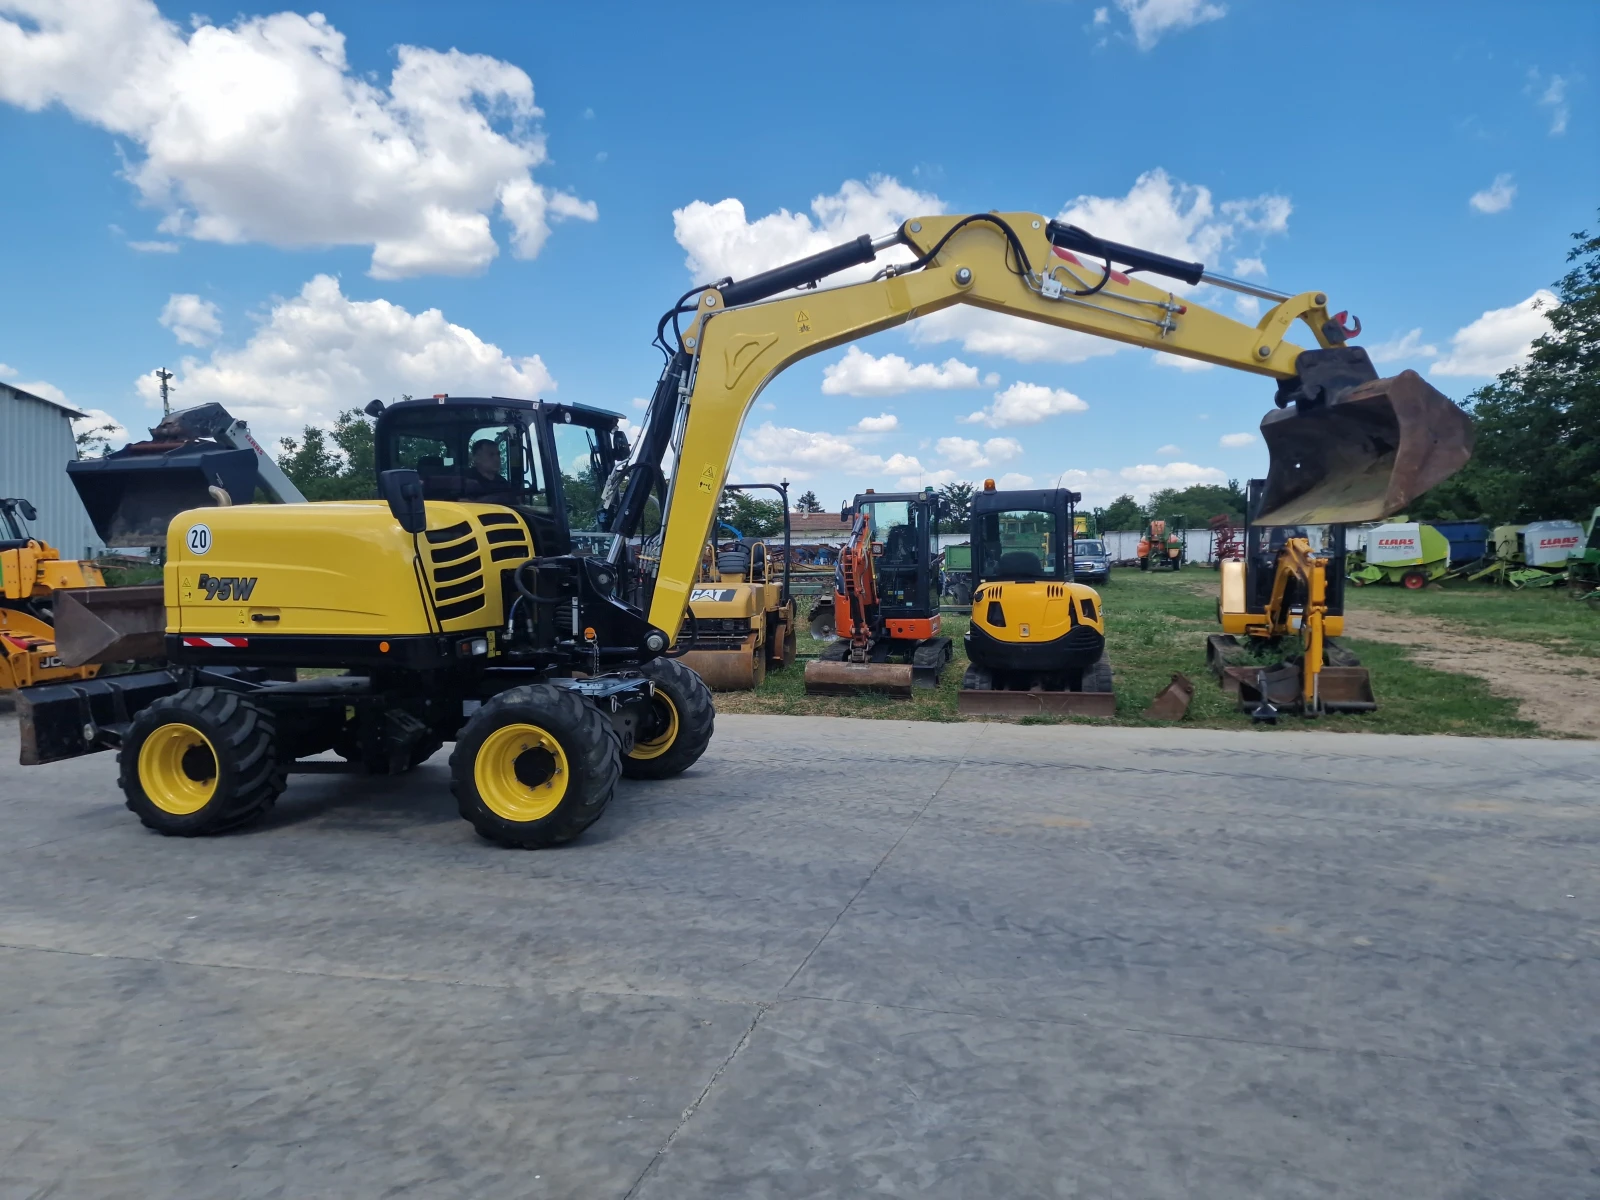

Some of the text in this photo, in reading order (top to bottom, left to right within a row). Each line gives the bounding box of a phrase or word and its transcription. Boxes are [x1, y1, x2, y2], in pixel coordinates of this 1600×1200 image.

[191, 529, 207, 549] 20
[1539, 536, 1579, 546] CLAAS
[690, 589, 727, 601] CAT
[40, 656, 65, 669] JC
